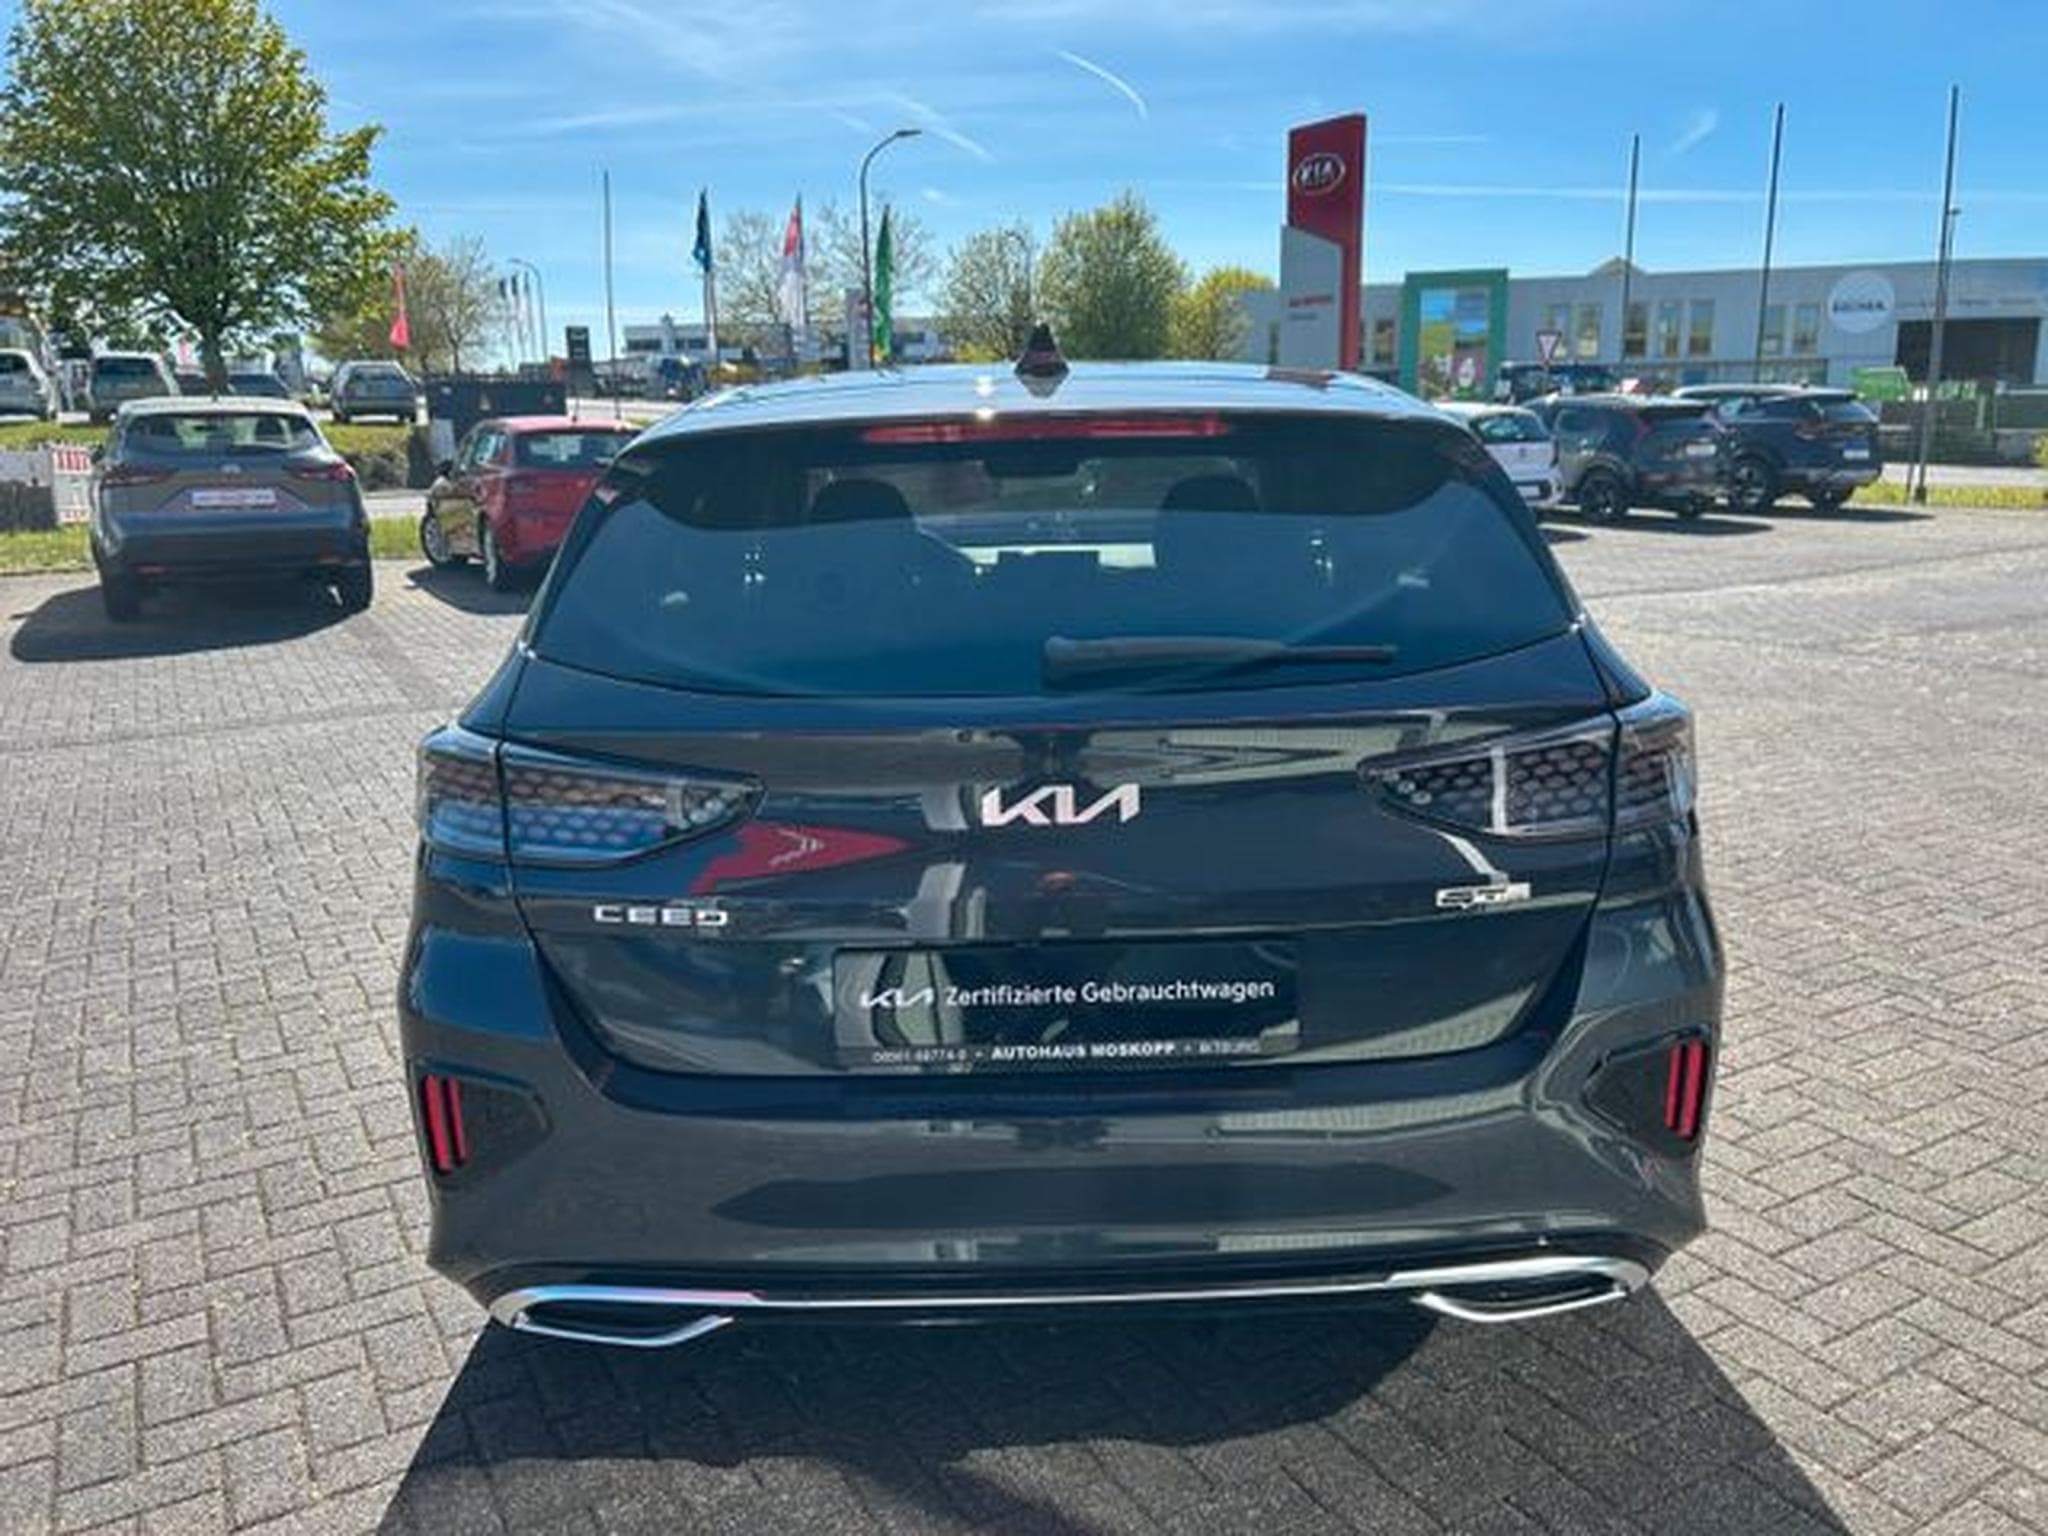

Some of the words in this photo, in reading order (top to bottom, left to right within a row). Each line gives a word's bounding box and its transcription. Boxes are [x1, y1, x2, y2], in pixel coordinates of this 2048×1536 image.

[982, 783, 1140, 826] KIA
[594, 904, 728, 927] CEED
[861, 988, 934, 1008] KIA
[946, 985, 1077, 1006] Zertifizierte
[1081, 981, 1275, 1004] Gebrauchtwagen
[991, 1045, 1086, 1060] AUTOHAUS
[1091, 1041, 1176, 1058] MOSKOPP
